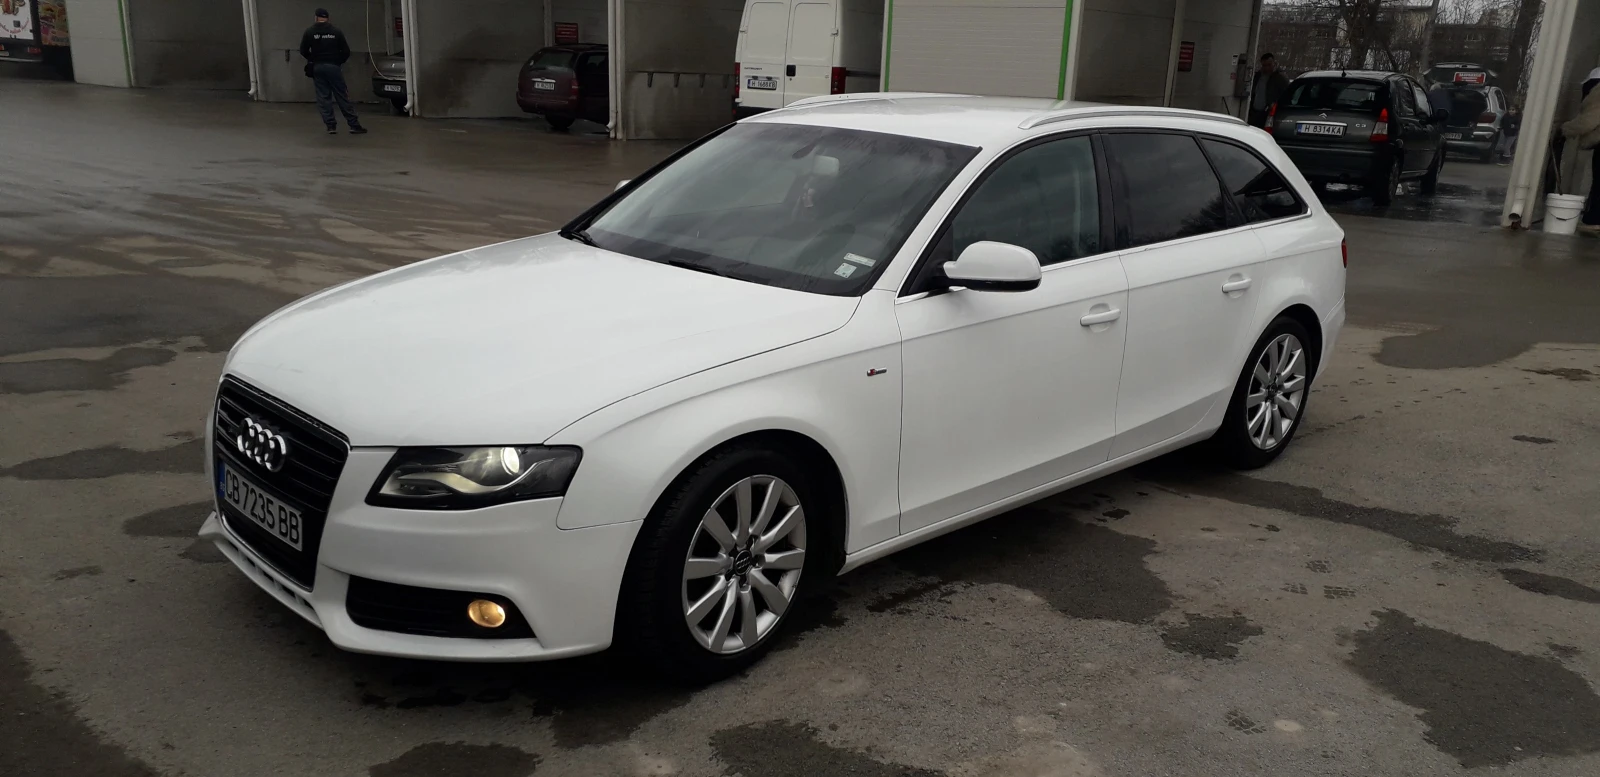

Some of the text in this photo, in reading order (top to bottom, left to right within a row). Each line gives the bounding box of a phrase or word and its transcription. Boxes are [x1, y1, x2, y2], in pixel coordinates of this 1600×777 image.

[226, 469, 299, 544] CB 7235 BB
